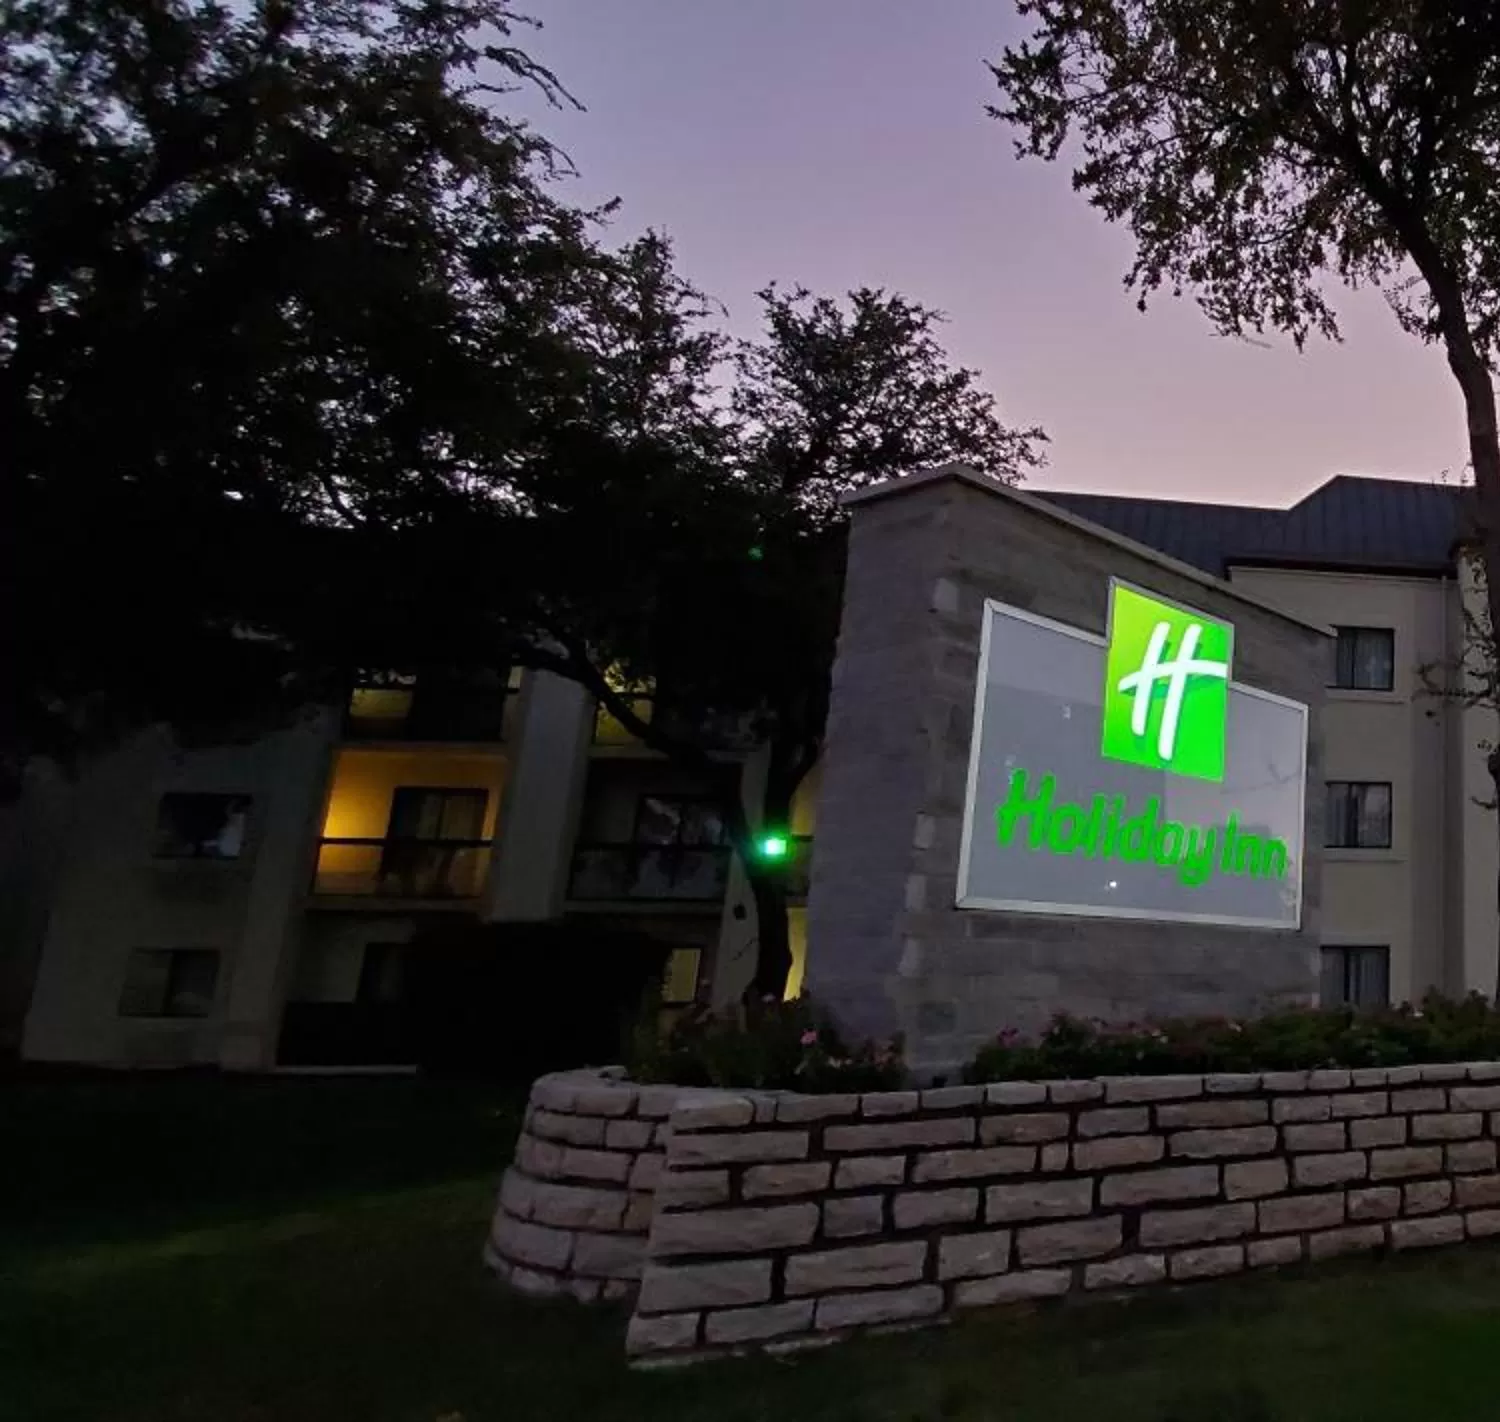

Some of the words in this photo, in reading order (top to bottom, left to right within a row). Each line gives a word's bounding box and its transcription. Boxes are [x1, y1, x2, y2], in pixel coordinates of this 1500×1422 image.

[1118, 620, 1228, 760] H
[995, 768, 1213, 887] Holiday
[1221, 809, 1289, 880] Inn
